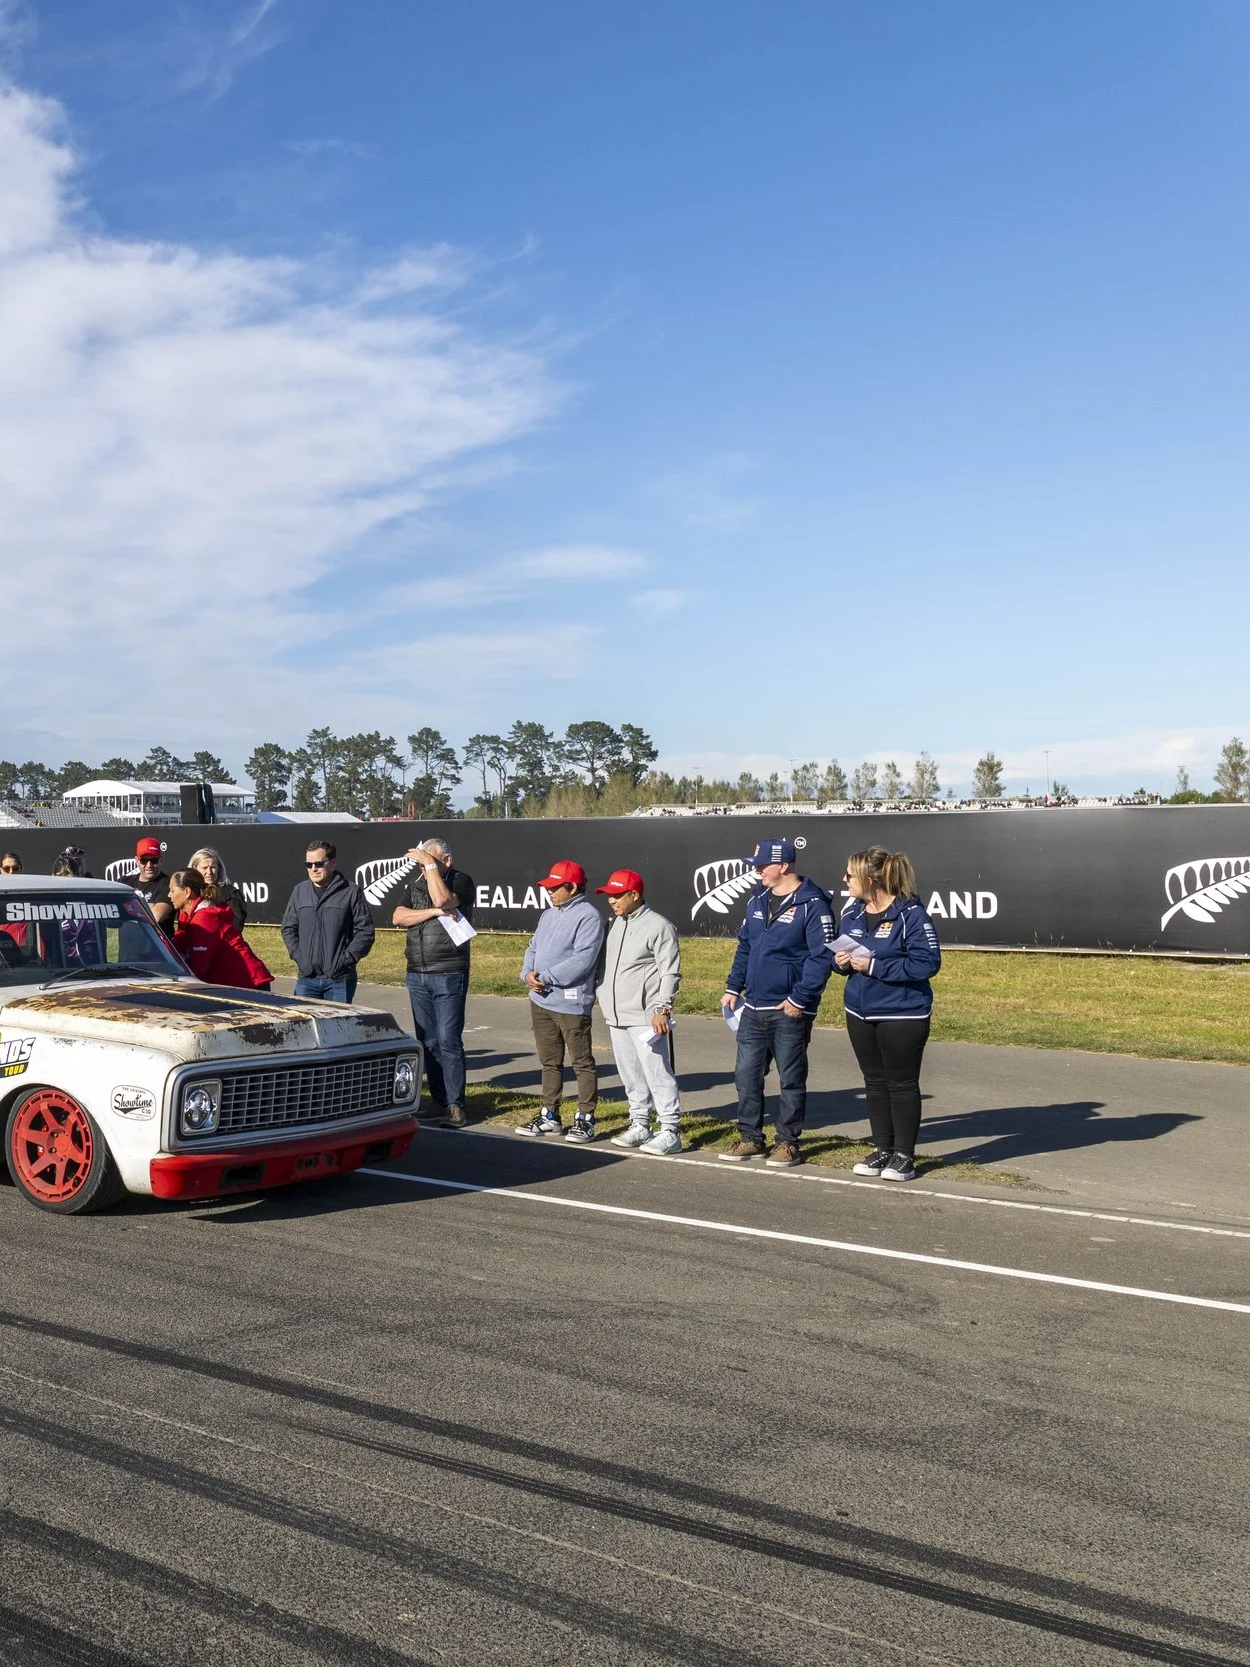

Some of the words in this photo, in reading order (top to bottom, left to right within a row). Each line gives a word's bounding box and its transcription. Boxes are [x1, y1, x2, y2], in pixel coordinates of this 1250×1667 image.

[6, 901, 120, 921] ShowTime
[4, 1064, 25, 1077] TOUR
[113, 1093, 153, 1108] Showtime
